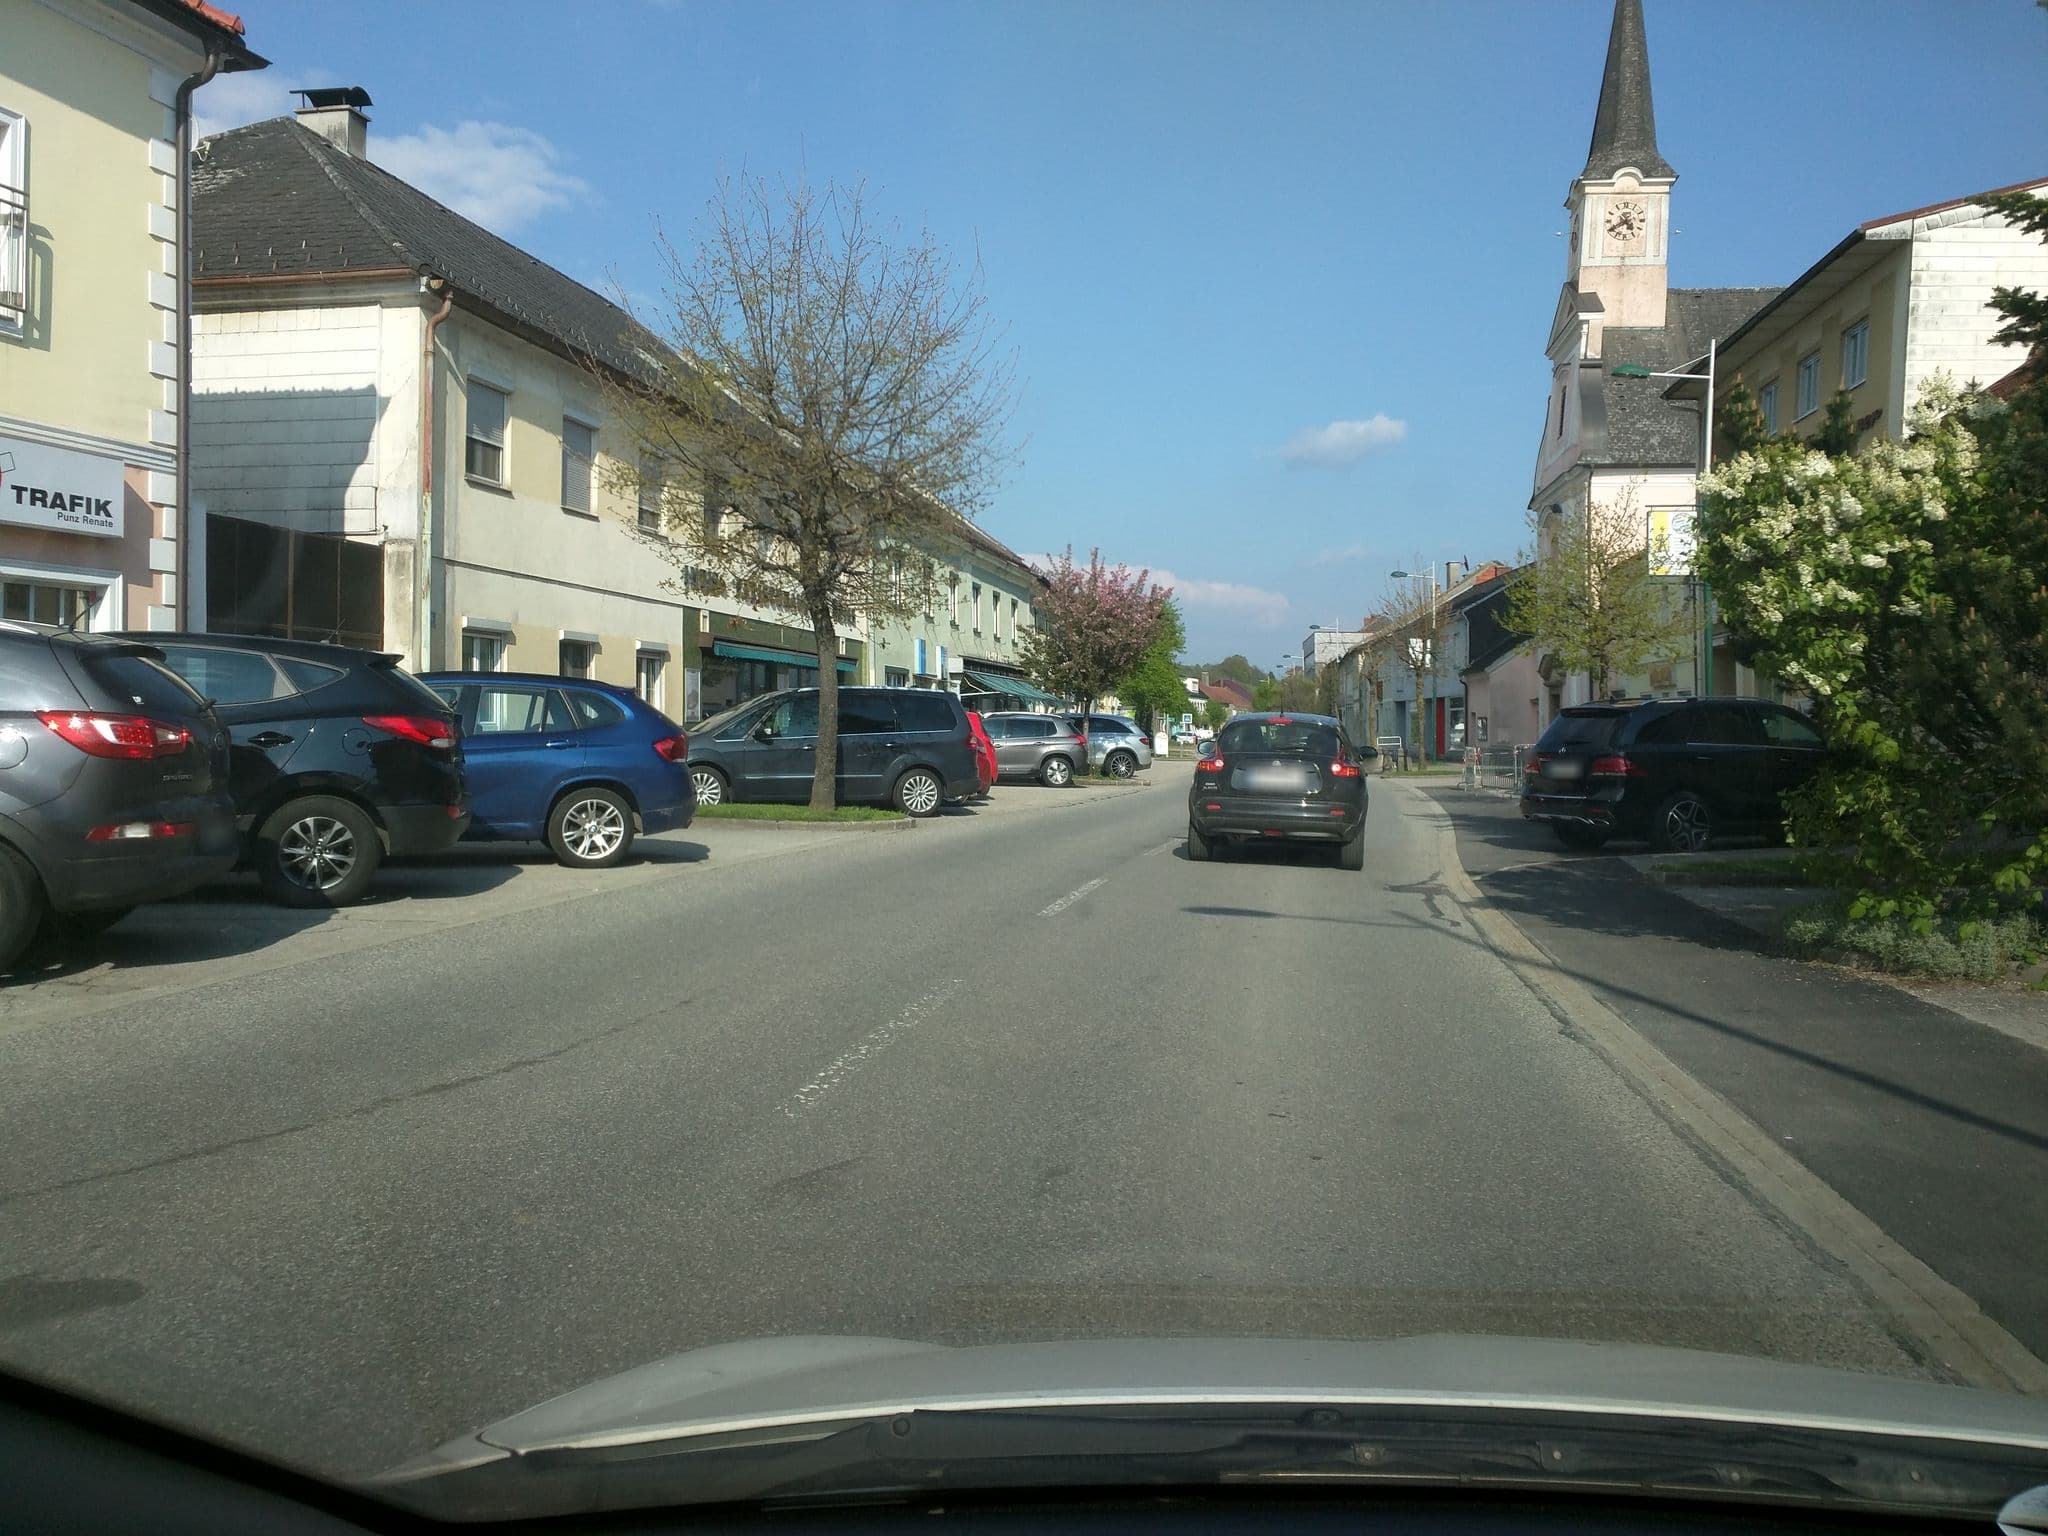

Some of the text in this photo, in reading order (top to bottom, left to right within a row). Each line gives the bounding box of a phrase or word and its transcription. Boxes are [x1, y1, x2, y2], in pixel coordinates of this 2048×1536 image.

[10, 484, 113, 518] TRAFIK
[57, 512, 114, 528] Punz Renate
